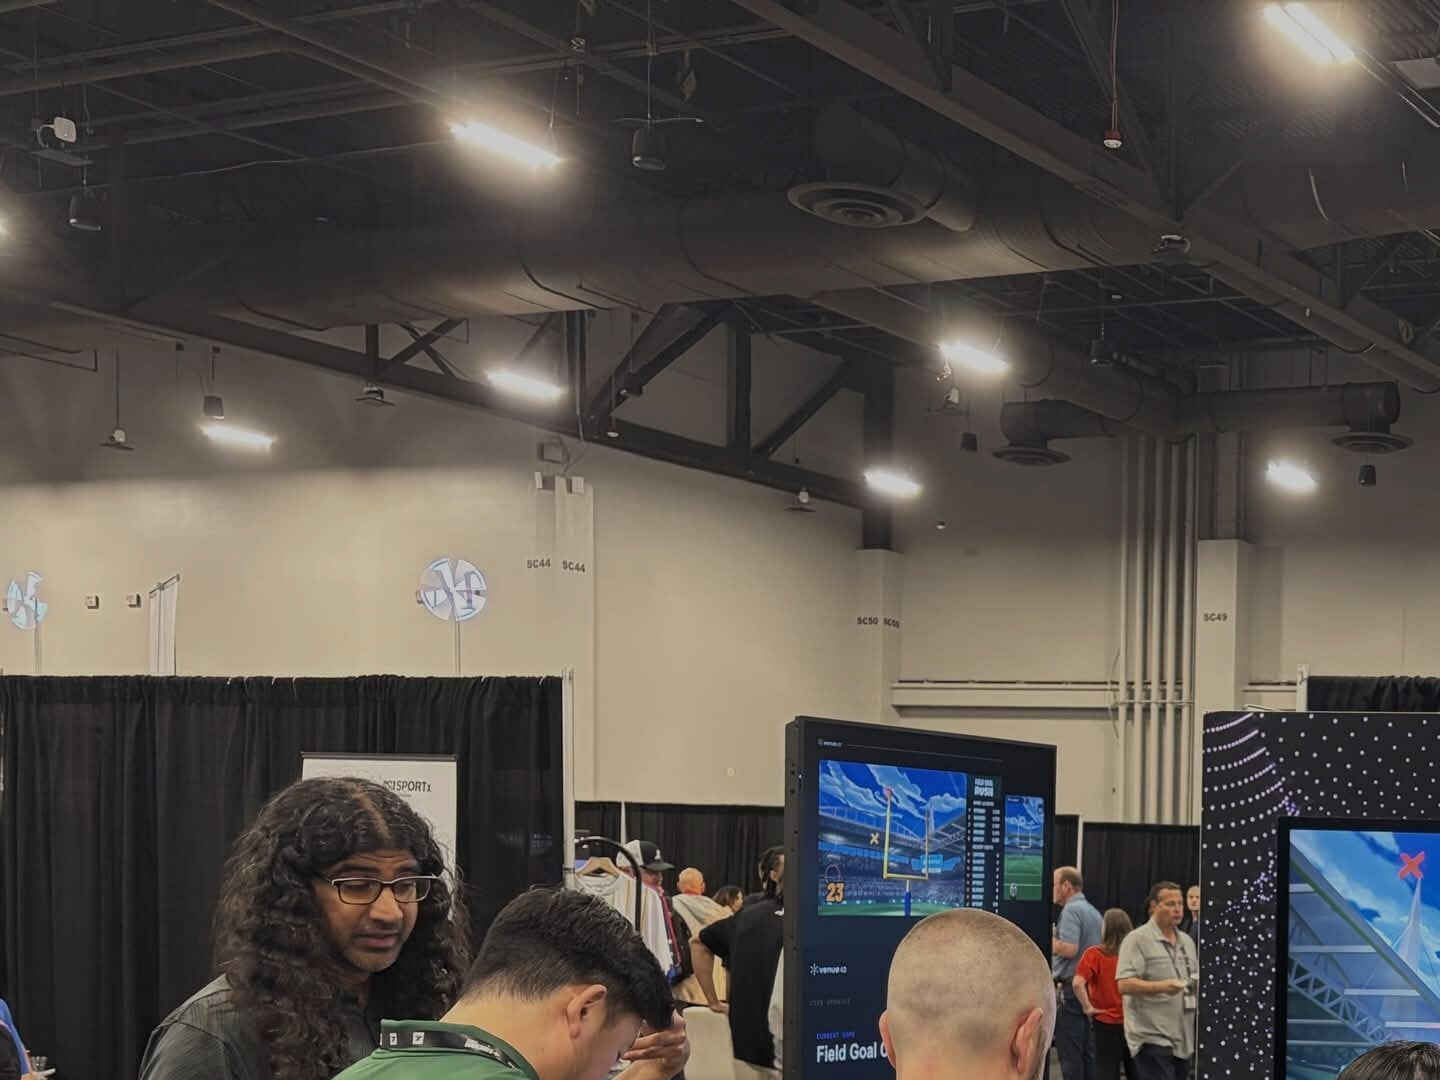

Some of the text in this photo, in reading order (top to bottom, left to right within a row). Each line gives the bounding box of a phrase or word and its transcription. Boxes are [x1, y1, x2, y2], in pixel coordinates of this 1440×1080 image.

[527, 558, 551, 569] SC44
[562, 560, 586, 573] SC44
[825, 882, 845, 903] 23
[816, 1044, 848, 1063] Field
[849, 1041, 878, 1060] Goal
